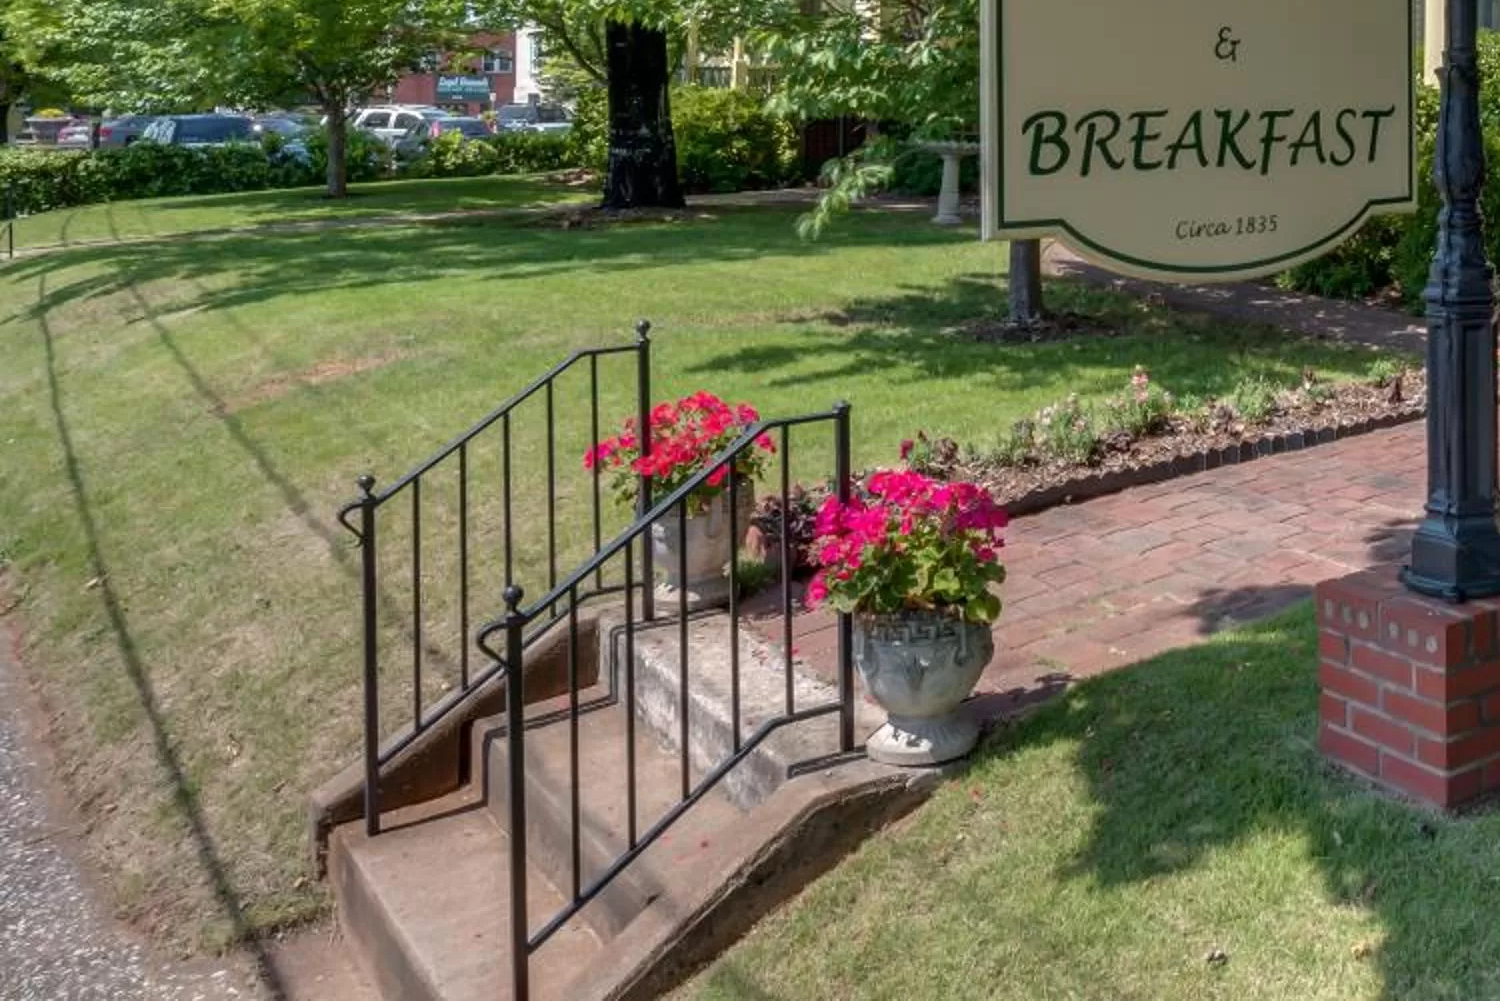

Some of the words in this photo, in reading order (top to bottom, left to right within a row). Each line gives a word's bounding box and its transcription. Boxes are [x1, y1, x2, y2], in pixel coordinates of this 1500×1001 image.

[1213, 26, 1241, 62] &
[1021, 105, 1396, 178] BREAKFAST
[1175, 220, 1232, 240] Circa
[1235, 214, 1279, 236] 1835
